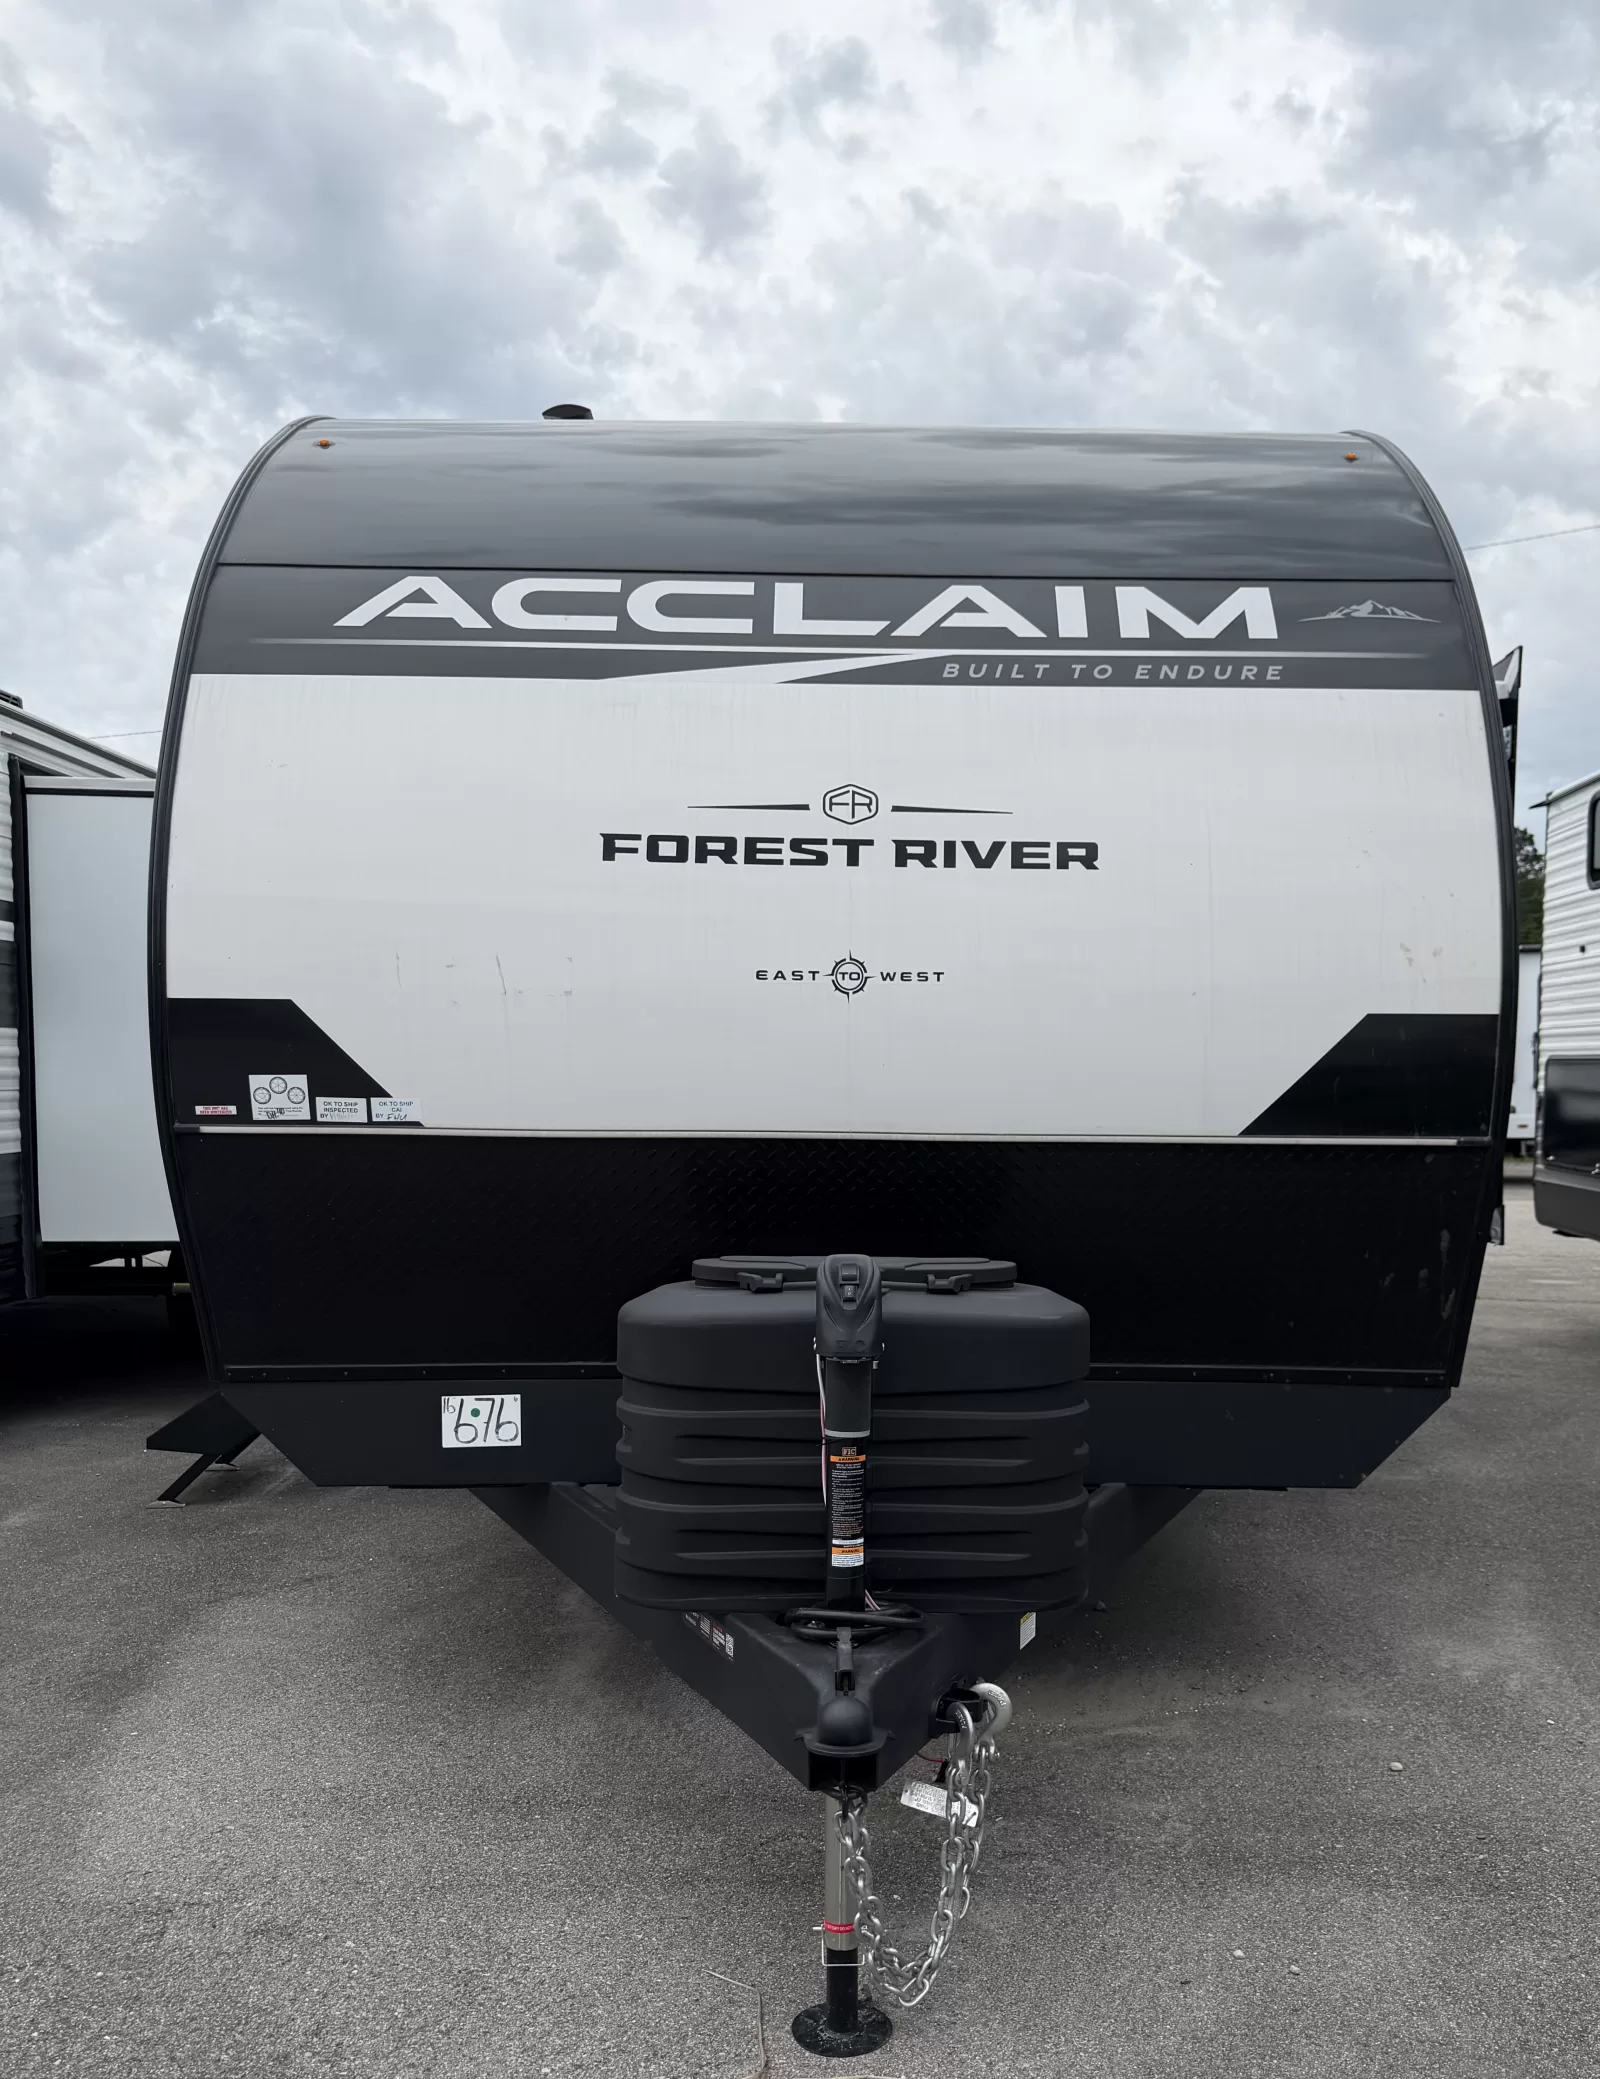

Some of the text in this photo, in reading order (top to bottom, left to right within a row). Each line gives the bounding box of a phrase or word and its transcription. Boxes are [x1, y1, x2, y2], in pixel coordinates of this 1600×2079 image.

[333, 575, 1279, 640] ACCLAIM
[942, 662, 1285, 682] BUILT TO ENDURE
[828, 789, 873, 819] FR
[599, 832, 1100, 871] FOREST RIVER
[755, 969, 945, 983] EAST TO WEST
[453, 1397, 520, 1444] 676
